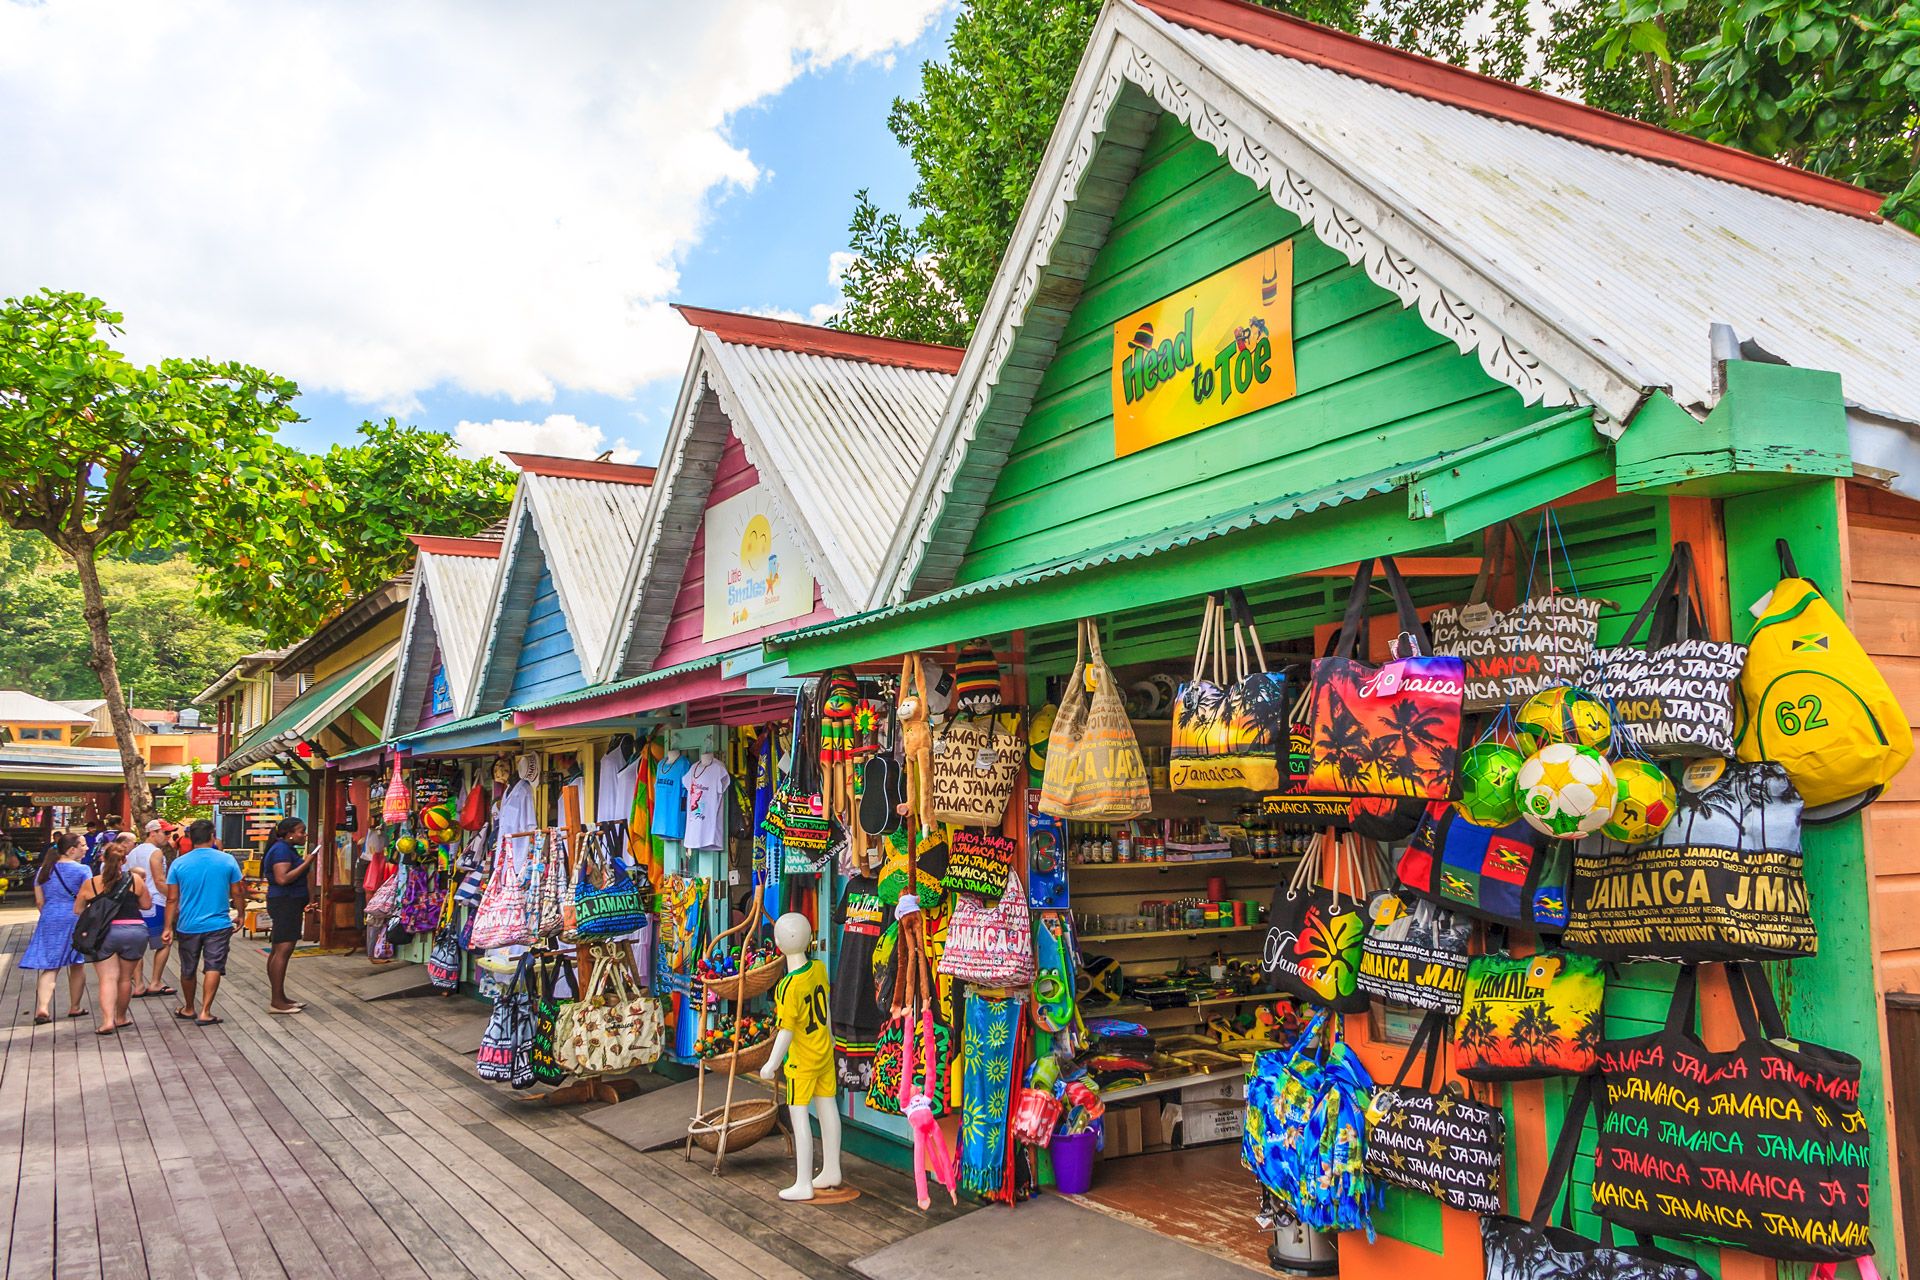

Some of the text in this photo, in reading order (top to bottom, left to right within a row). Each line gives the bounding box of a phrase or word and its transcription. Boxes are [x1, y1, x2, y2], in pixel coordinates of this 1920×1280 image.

[1122, 307, 1194, 405] Head
[1192, 337, 1271, 405] to Toe
[728, 568, 742, 585] Little
[728, 578, 766, 606] Smiles
[1360, 670, 1462, 698] Jmaica
[1776, 694, 1829, 736] 62
[1173, 765, 1245, 786] Jamaica
[1684, 847, 1739, 862] JAMAICA
[593, 895, 638, 914] JAMAICA
[1586, 869, 1711, 911] JAMAICA
[946, 926, 1007, 953] JAMAICA
[1262, 927, 1338, 986] Jamaica
[804, 984, 827, 1035] 10
[1622, 1078, 1700, 1116] JAMAICA
[1707, 1093, 1803, 1122] JAMAICA
[1374, 1128, 1424, 1152] JAMAICA
[1657, 1120, 1744, 1155] JAMAICA
[1611, 1148, 1690, 1185] JAMAICA
[1700, 1167, 1805, 1203] JAMAICA
[1819, 1180, 1846, 1207] JA
[1656, 1194, 1752, 1230] JAMAICA
